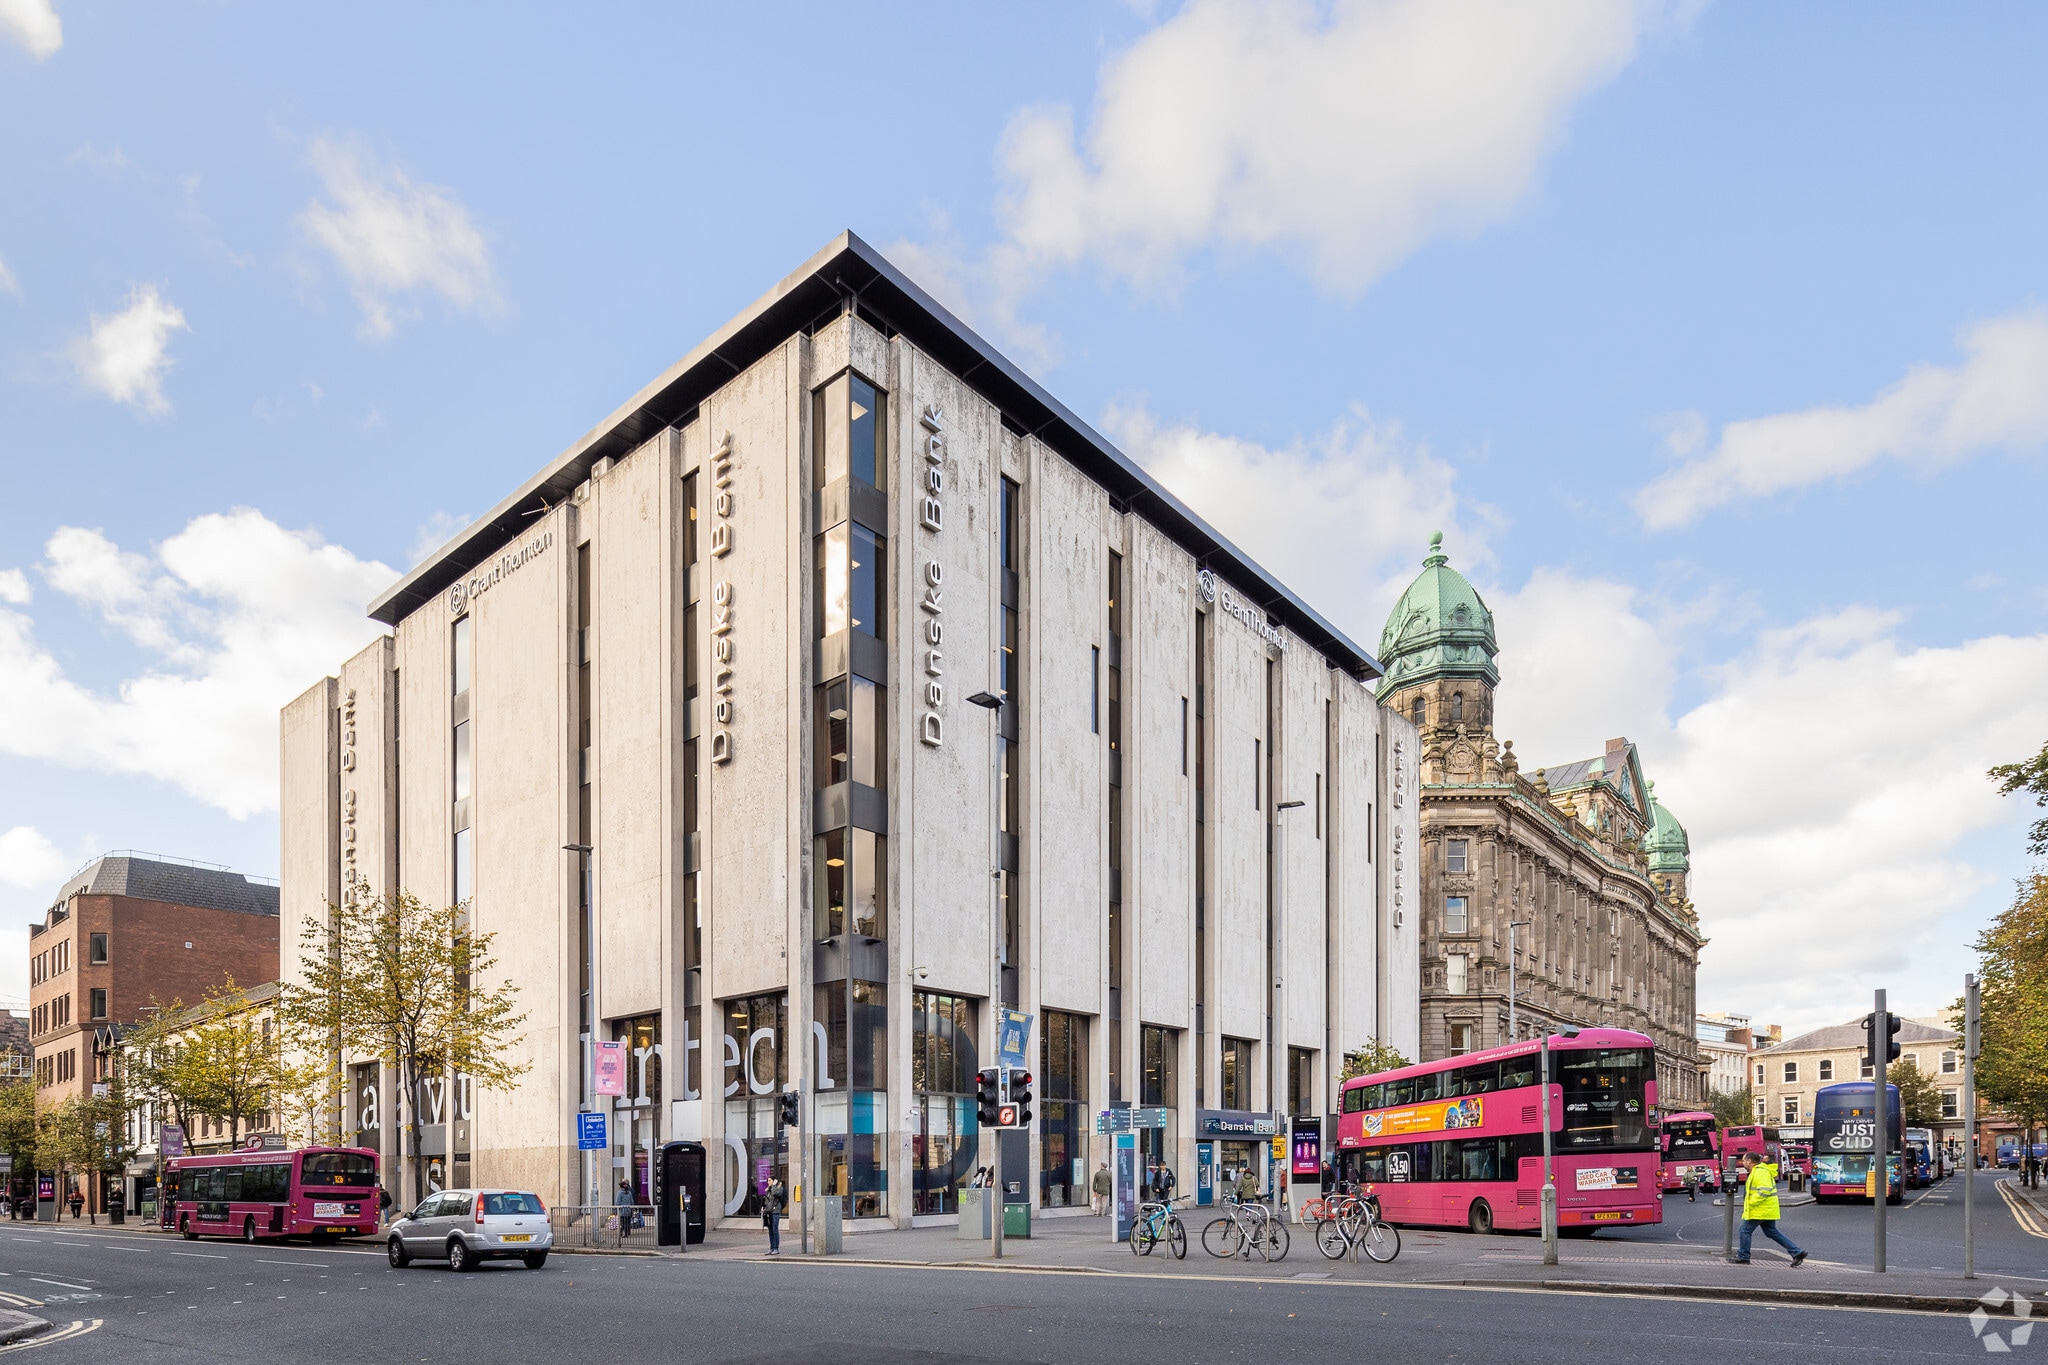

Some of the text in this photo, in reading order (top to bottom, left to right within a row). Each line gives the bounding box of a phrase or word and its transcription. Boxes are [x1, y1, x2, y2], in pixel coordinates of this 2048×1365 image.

[468, 565, 501, 599] Grant
[920, 404, 943, 747] Danske Bank
[711, 429, 733, 765] Danske Bank
[1222, 591, 1289, 653] Grant Thornton
[1221, 1121, 1275, 1132] Danske Ban
[1837, 1124, 1876, 1136] JUST
[1829, 1136, 1874, 1149] GLID
[1389, 1155, 1408, 1175] £3.50
[1577, 1173, 1594, 1181] USED
[1578, 1175, 1613, 1186] WARRANTY
